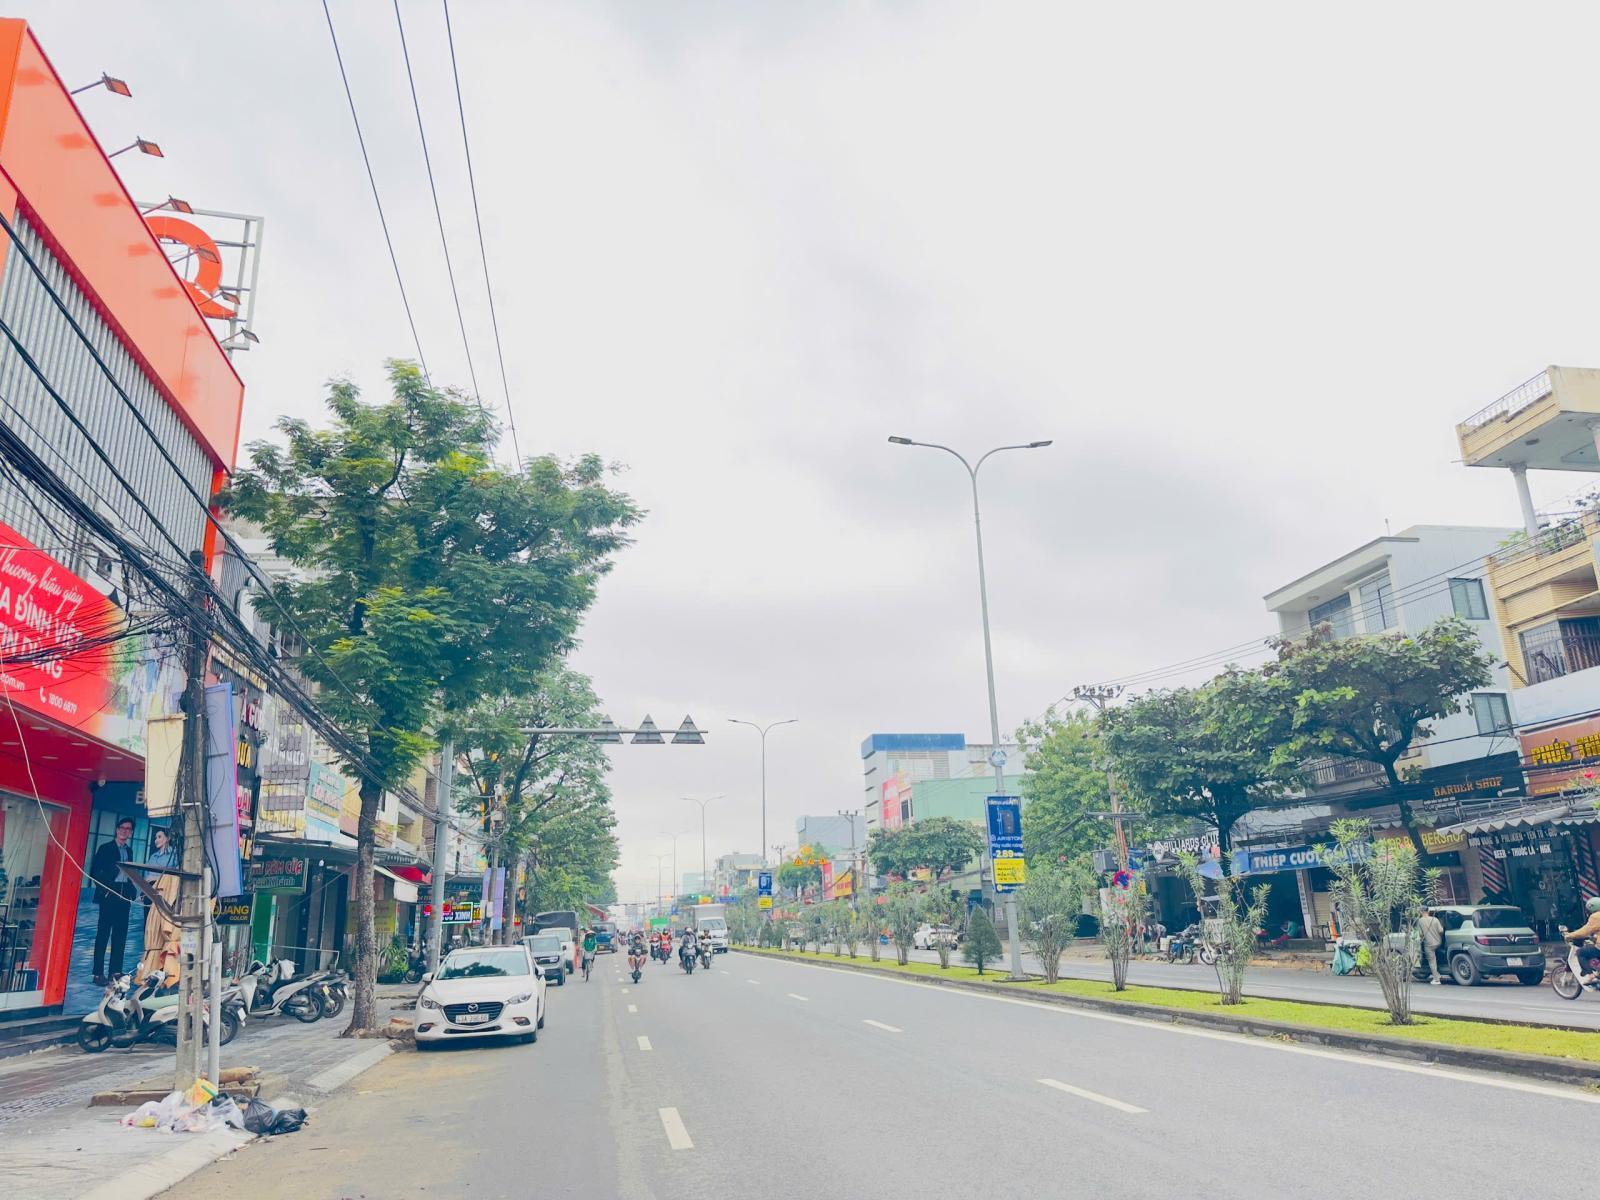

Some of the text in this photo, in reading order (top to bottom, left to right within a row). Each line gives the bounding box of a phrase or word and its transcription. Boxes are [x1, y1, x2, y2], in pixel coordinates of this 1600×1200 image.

[1531, 736, 1572, 766] PHÚC
[1433, 776, 1503, 797] BARBER SHOP
[1164, 837, 1200, 852] BILLIARDS
[1253, 852, 1286, 870] THIỆP
